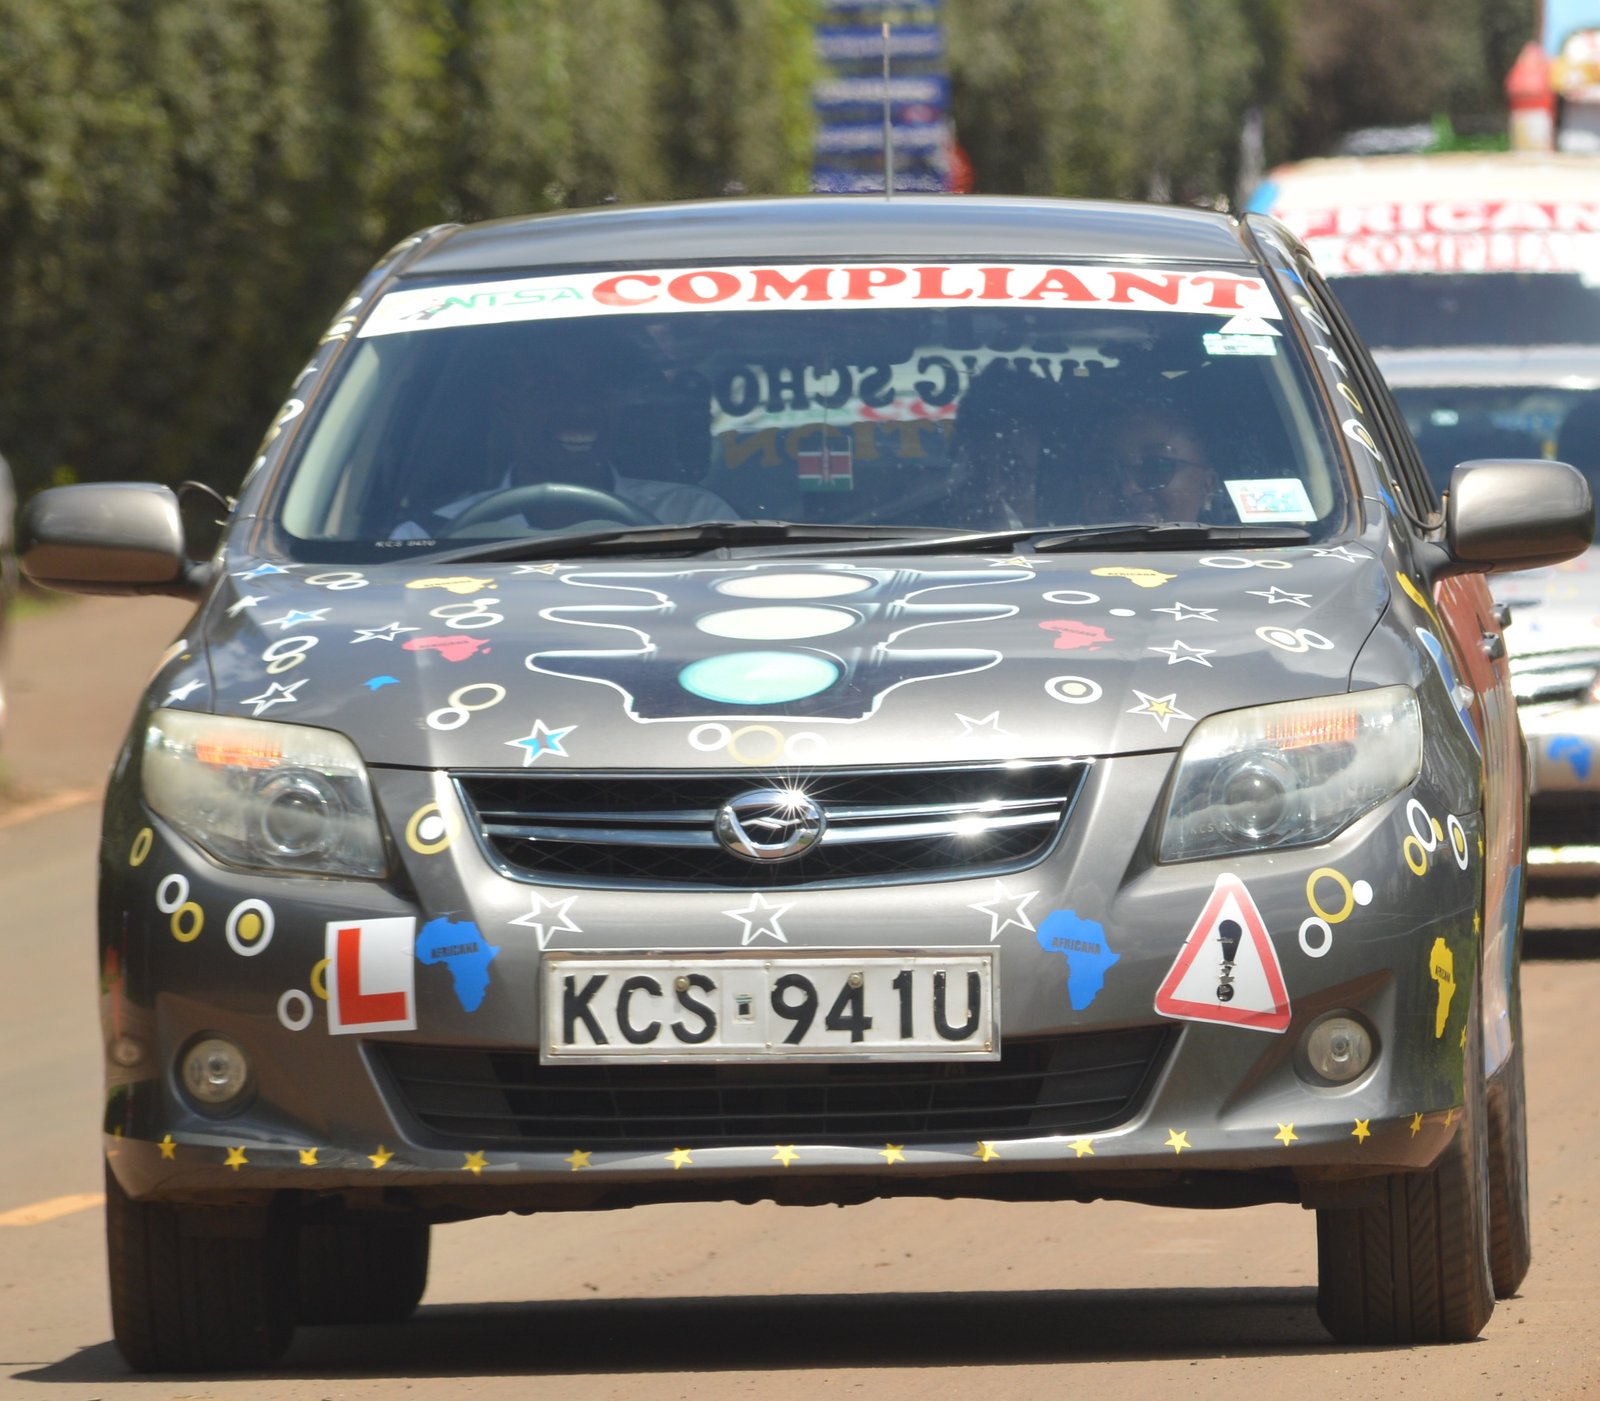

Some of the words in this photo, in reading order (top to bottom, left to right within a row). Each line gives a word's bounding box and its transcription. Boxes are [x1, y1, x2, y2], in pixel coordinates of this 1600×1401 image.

[442, 286, 584, 310] NTSA
[592, 266, 1260, 309] COMPLIANT
[431, 942, 479, 959] AFRICANA
[1051, 936, 1101, 955] AFRICANA
[337, 928, 408, 1025] L
[562, 973, 718, 1045] KCS
[770, 969, 982, 1045] 941U
